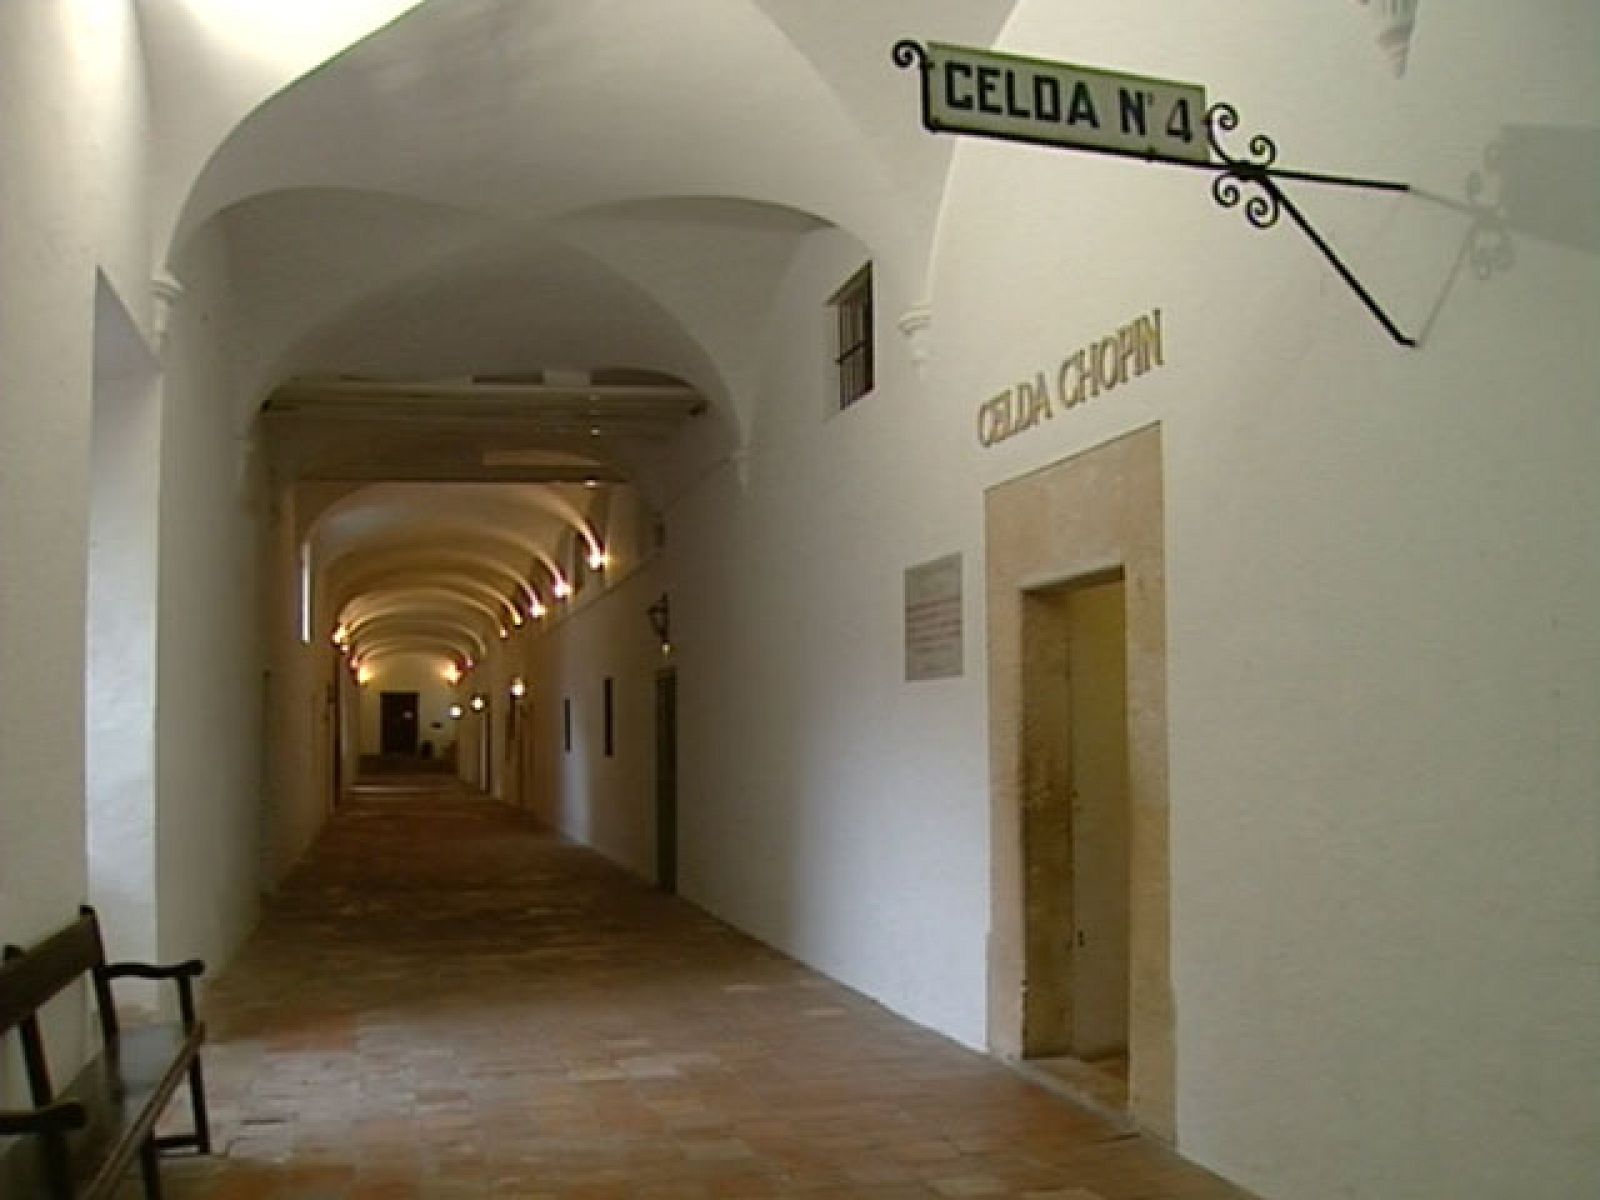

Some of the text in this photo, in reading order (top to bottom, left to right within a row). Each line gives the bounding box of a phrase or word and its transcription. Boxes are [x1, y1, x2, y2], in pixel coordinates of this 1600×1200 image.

[945, 60, 1100, 128] CELDA
[1165, 97, 1193, 143] 4
[1058, 308, 1164, 409] CHOPIN
